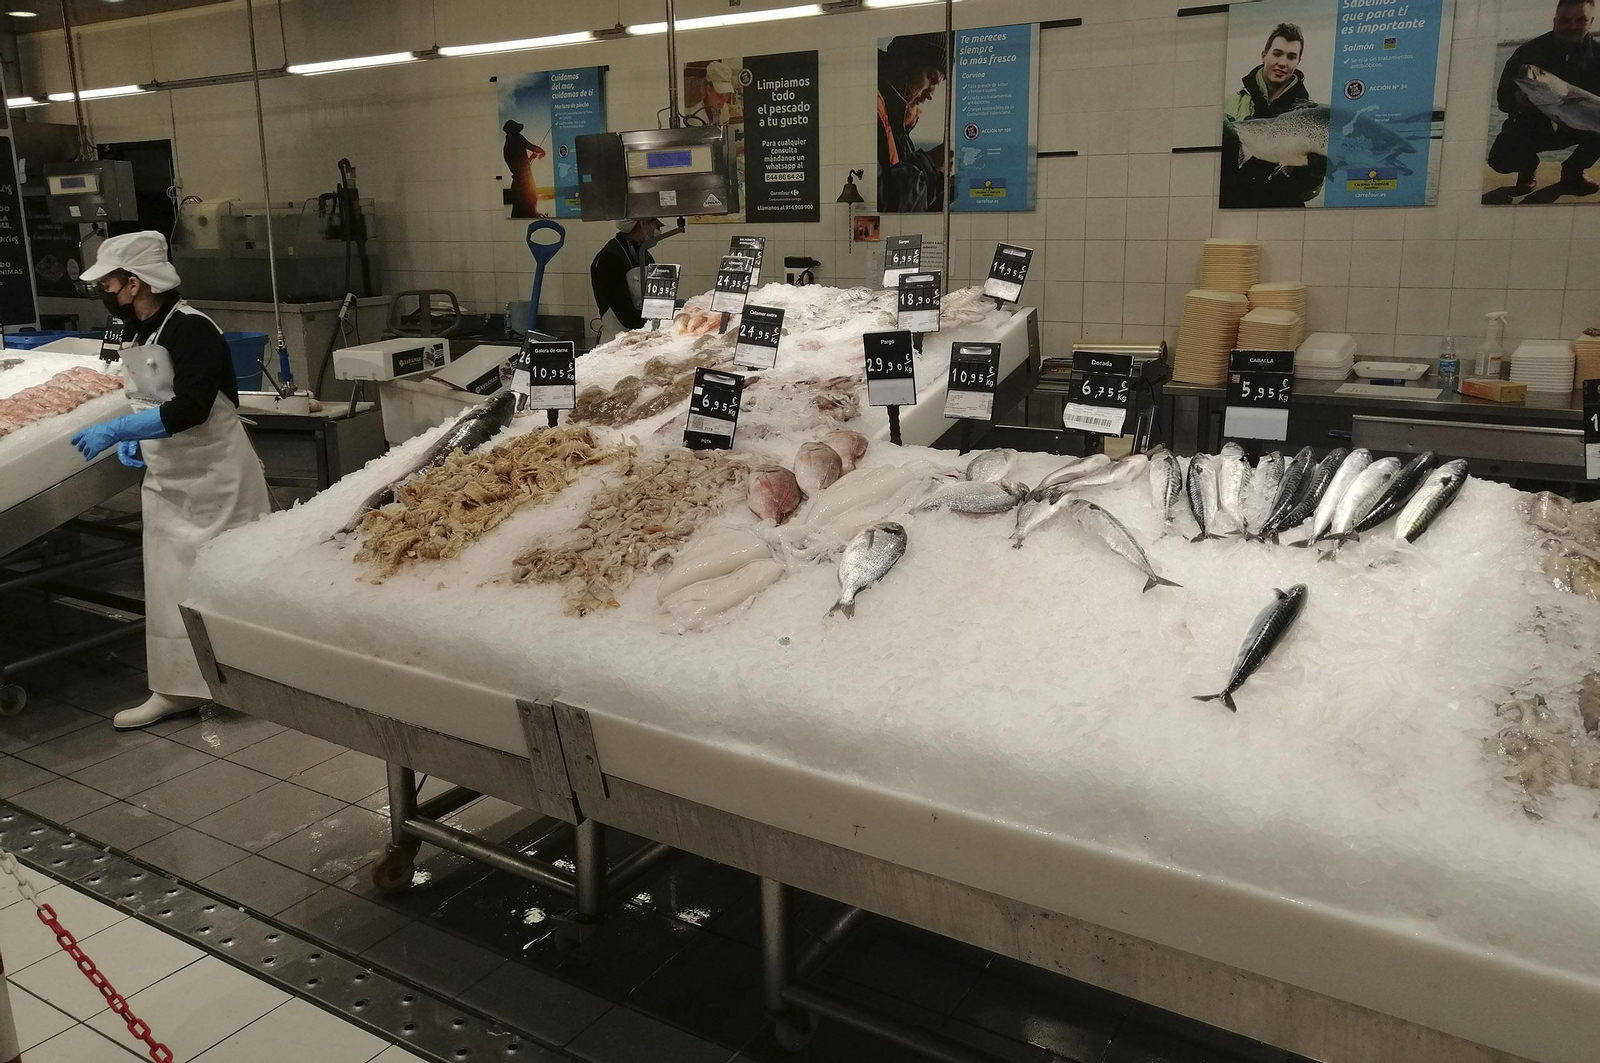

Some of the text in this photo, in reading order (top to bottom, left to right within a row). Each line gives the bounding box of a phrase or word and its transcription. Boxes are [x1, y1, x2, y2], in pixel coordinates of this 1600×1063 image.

[1342, 6, 1408, 23] que para ti
[1341, 18, 1426, 34] es importante
[960, 33, 1007, 44] Te mereces
[960, 44, 994, 55] siempre
[1343, 42, 1374, 52] Salmón
[960, 54, 1017, 66] lo más fresco
[551, 73, 580, 82] Cuidamos
[757, 78, 810, 90] Limpiamos
[552, 82, 560, 90] del
[552, 91, 579, 100] cuidamos
[588, 88, 594, 96] ti
[771, 90, 796, 102] todo
[758, 101, 810, 116] el pescado
[759, 115, 808, 128] a tu gusto
[777, 138, 806, 146] cualquier
[770, 146, 798, 154] consulta
[764, 154, 796, 162] mándanos
[893, 253, 912, 264] 6,95
[994, 262, 1017, 276] 14,95
[717, 275, 741, 288] 24,95
[647, 282, 669, 296] 10,95
[900, 293, 930, 306] 18,90
[740, 324, 770, 340] 24,95
[866, 358, 902, 374] 29,90
[1091, 359, 1112, 367] Dorada
[532, 365, 564, 380] 10,95
[952, 368, 984, 385] 10,95
[1082, 380, 1114, 398] 6,75
[1242, 380, 1274, 401] 5,95
[702, 394, 728, 412] 6,95
